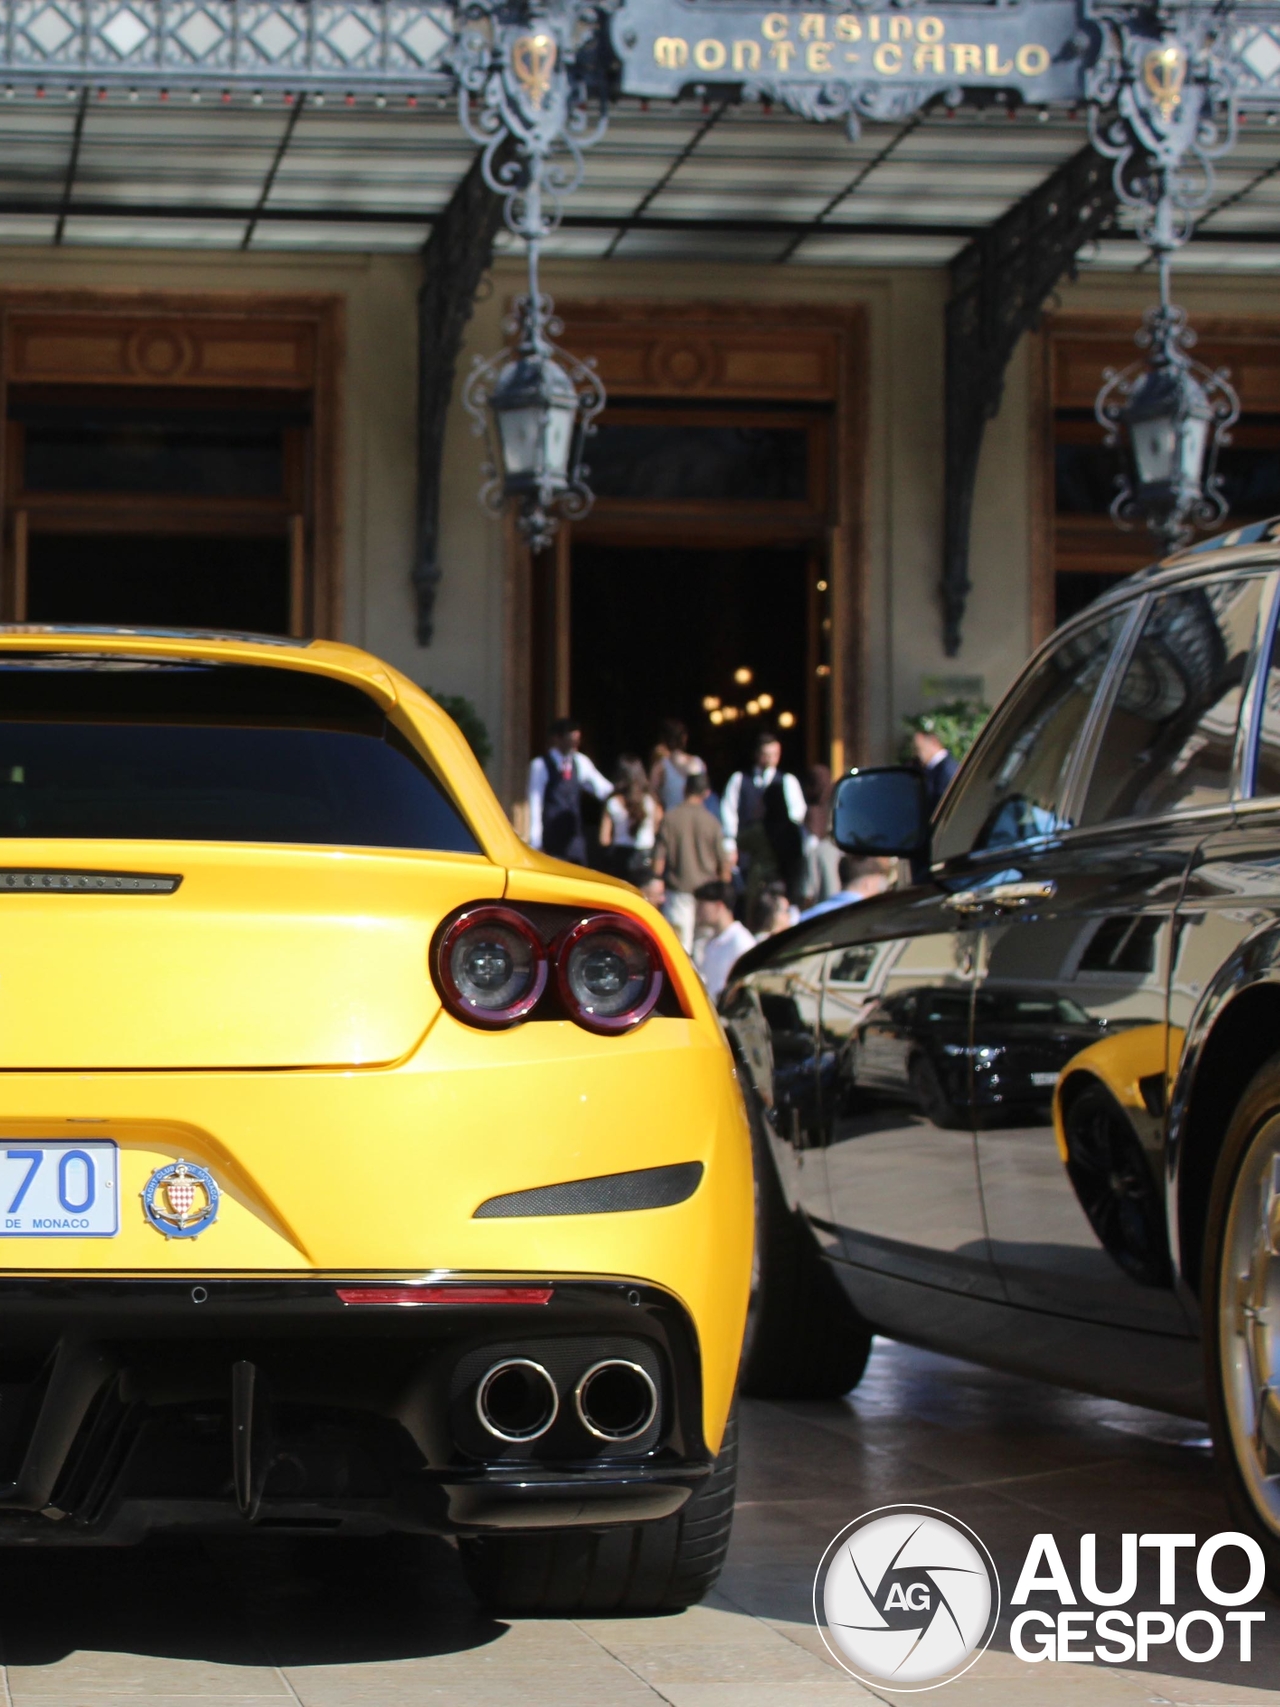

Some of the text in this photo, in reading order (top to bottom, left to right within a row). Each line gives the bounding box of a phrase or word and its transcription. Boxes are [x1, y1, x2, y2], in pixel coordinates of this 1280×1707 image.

[761, 12, 945, 41] CASINO
[653, 36, 1051, 76] MONTE-CARLO
[146, 1179, 158, 1202] YACHT
[156, 1165, 175, 1178] CLUB
[198, 1171, 218, 1200] MONACO
[5, 1218, 22, 1229] DE
[32, 1218, 90, 1229] MONACO
